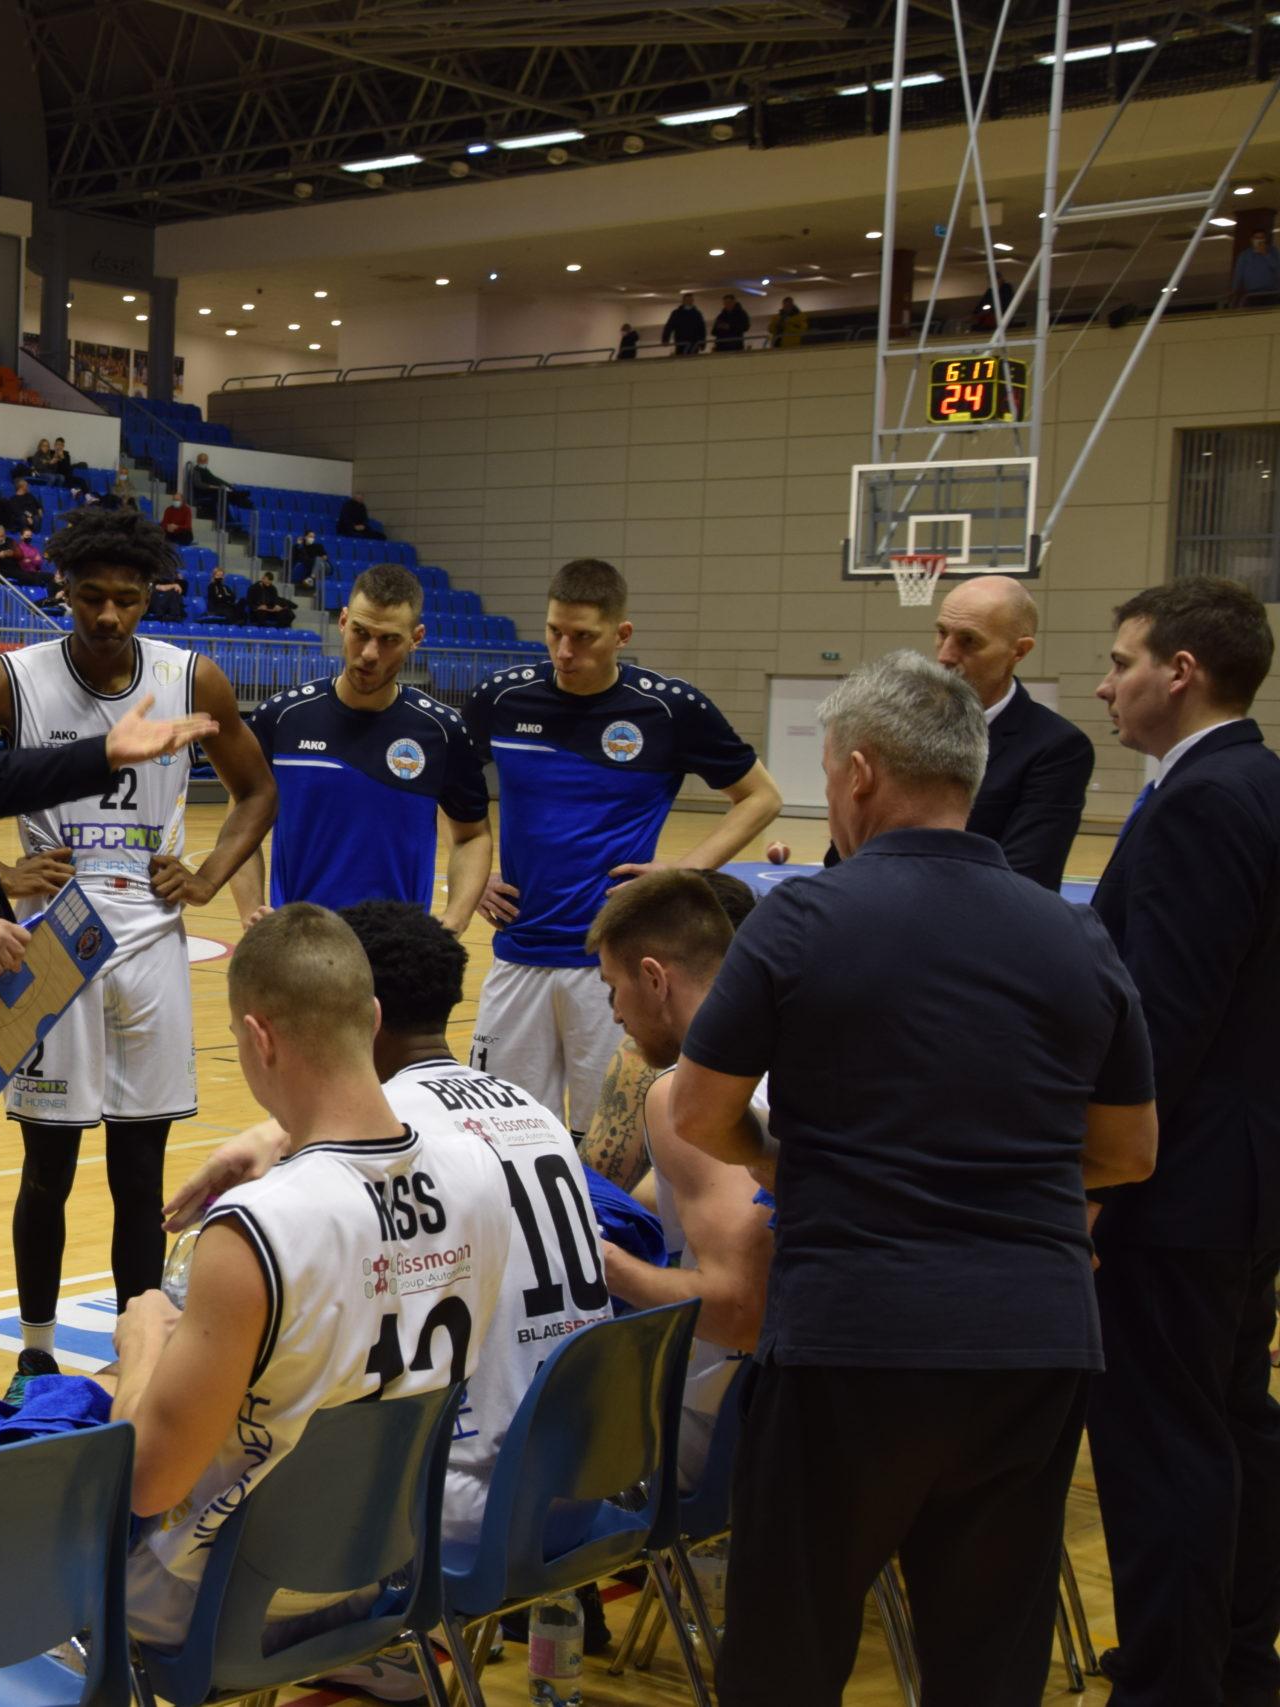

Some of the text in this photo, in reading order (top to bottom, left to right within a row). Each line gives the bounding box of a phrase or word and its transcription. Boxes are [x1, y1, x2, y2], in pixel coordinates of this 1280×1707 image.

[940, 383, 985, 415] 24
[48, 729, 78, 742] JAKO
[515, 722, 543, 734] JAKO
[297, 739, 328, 751] JAKO
[18, 1039, 44, 1078] 2
[417, 1075, 529, 1111] BRYCE
[363, 1171, 447, 1242] KSS
[502, 1153, 609, 1319] 10
[396, 1244, 471, 1276] Eissmann
